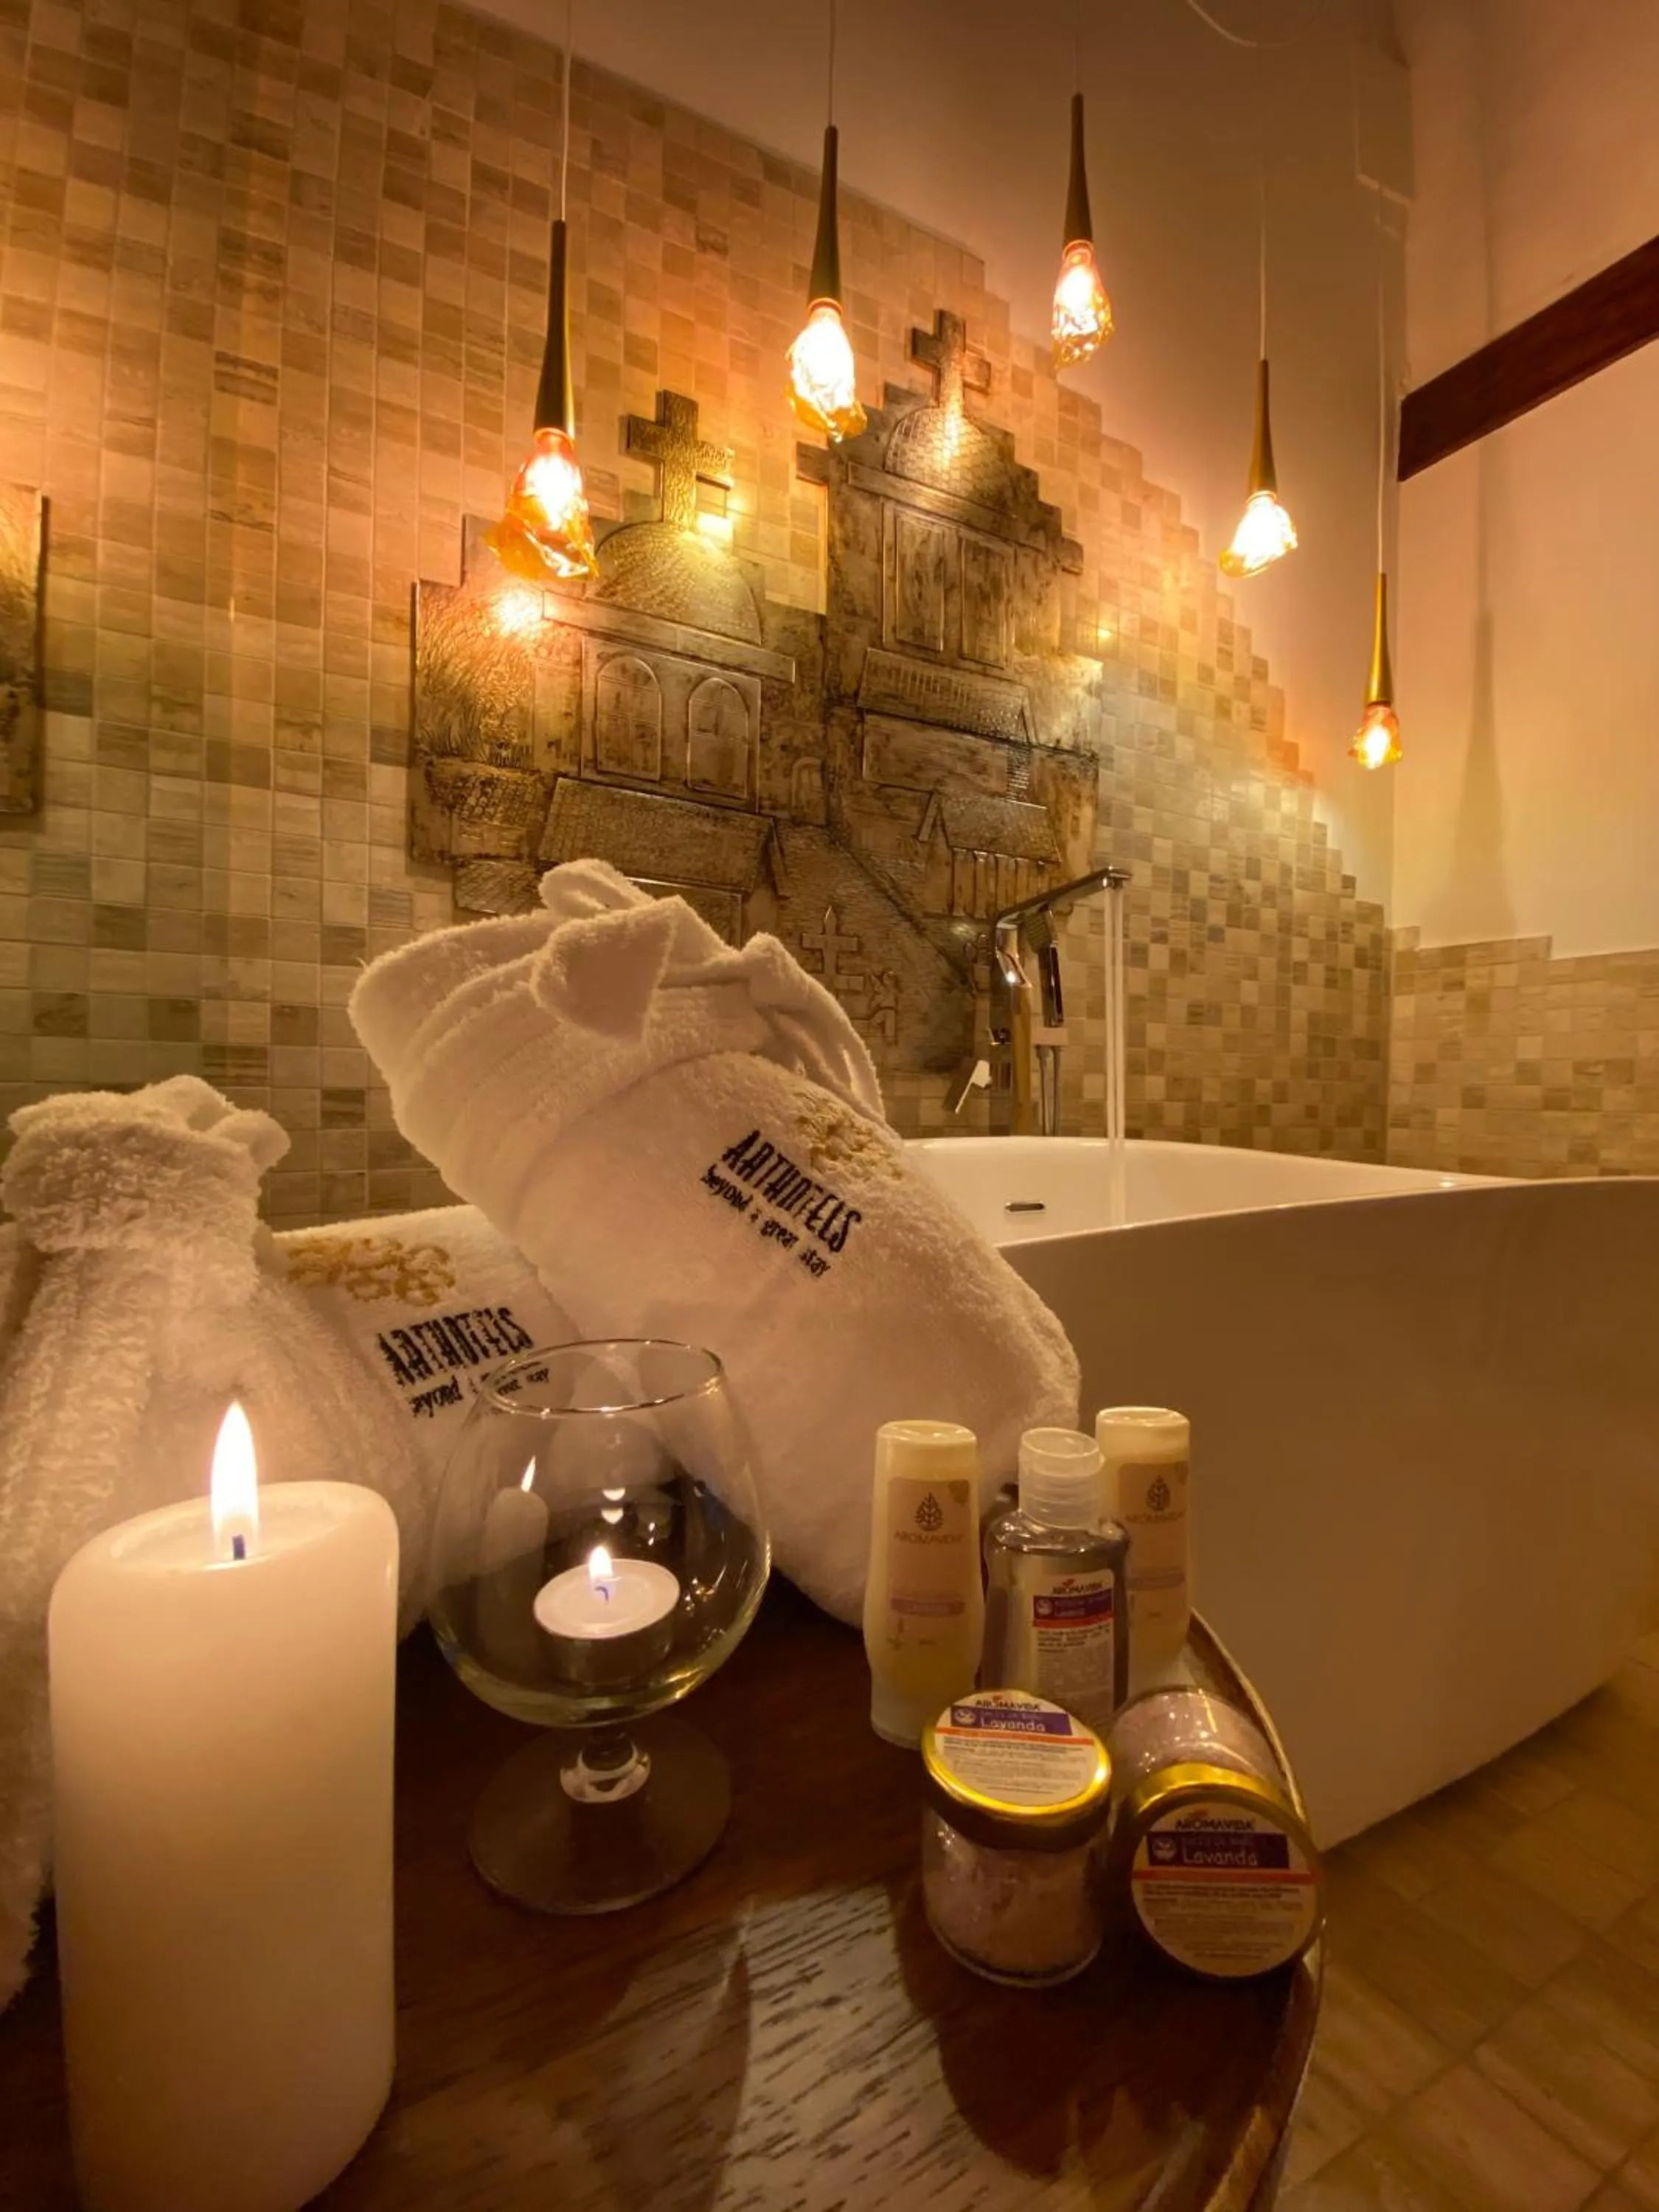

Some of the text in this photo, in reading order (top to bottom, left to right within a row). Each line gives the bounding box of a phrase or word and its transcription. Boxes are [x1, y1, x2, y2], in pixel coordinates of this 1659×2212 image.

[799, 1247, 832, 1278] stay
[981, 1716, 1046, 1732] Lavanda
[1182, 1845, 1258, 1866] Lavanda
